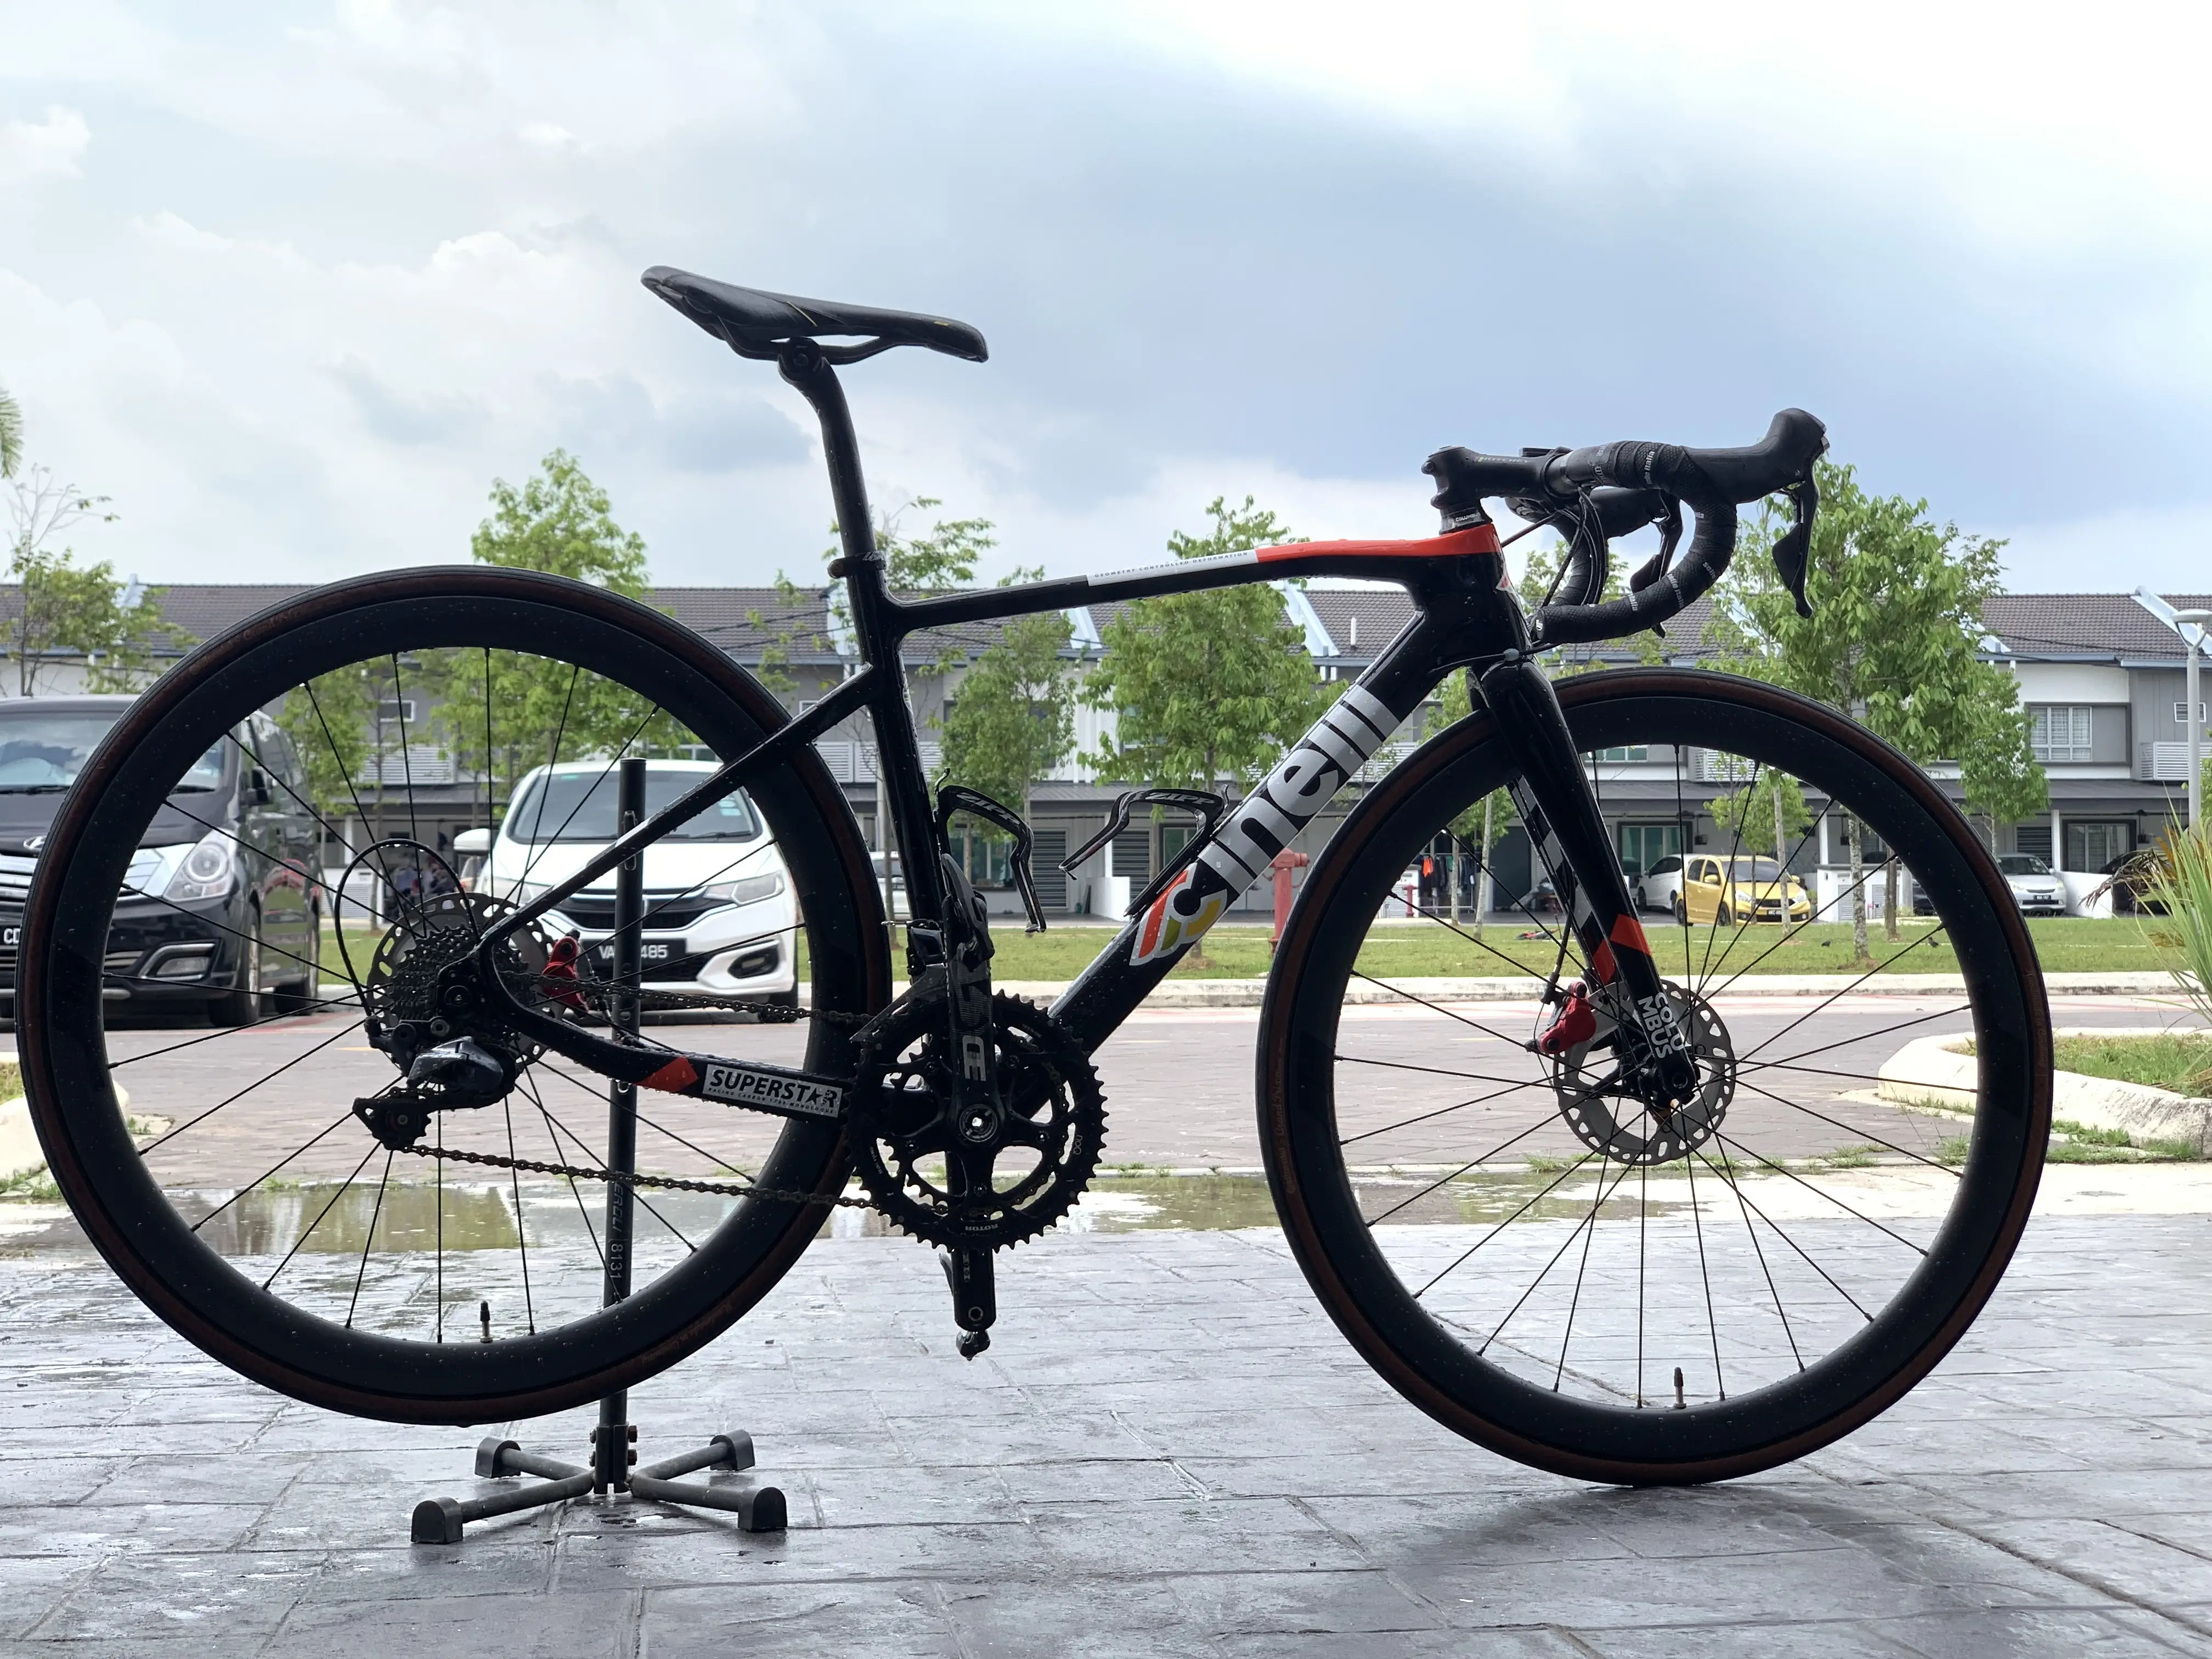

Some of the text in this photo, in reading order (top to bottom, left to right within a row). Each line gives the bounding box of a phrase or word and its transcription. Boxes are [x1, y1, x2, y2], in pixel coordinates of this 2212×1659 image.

[1644, 451, 1655, 471] italia
[1095, 551, 1248, 578] GEOMETRY CONTROLLED DEFORMATION
[956, 792, 1020, 825] ZIPP
[1145, 792, 1215, 804] ZIPP
[1130, 685, 1401, 966] cinelli
[1637, 996, 1673, 1057] MBUS
[1657, 991, 1684, 1050] COLU
[708, 1087, 734, 1096] RACING
[738, 1092, 766, 1101] CARBON
[789, 1102, 834, 1114] MONOCOQUE
[610, 1243, 623, 1279] 8131
